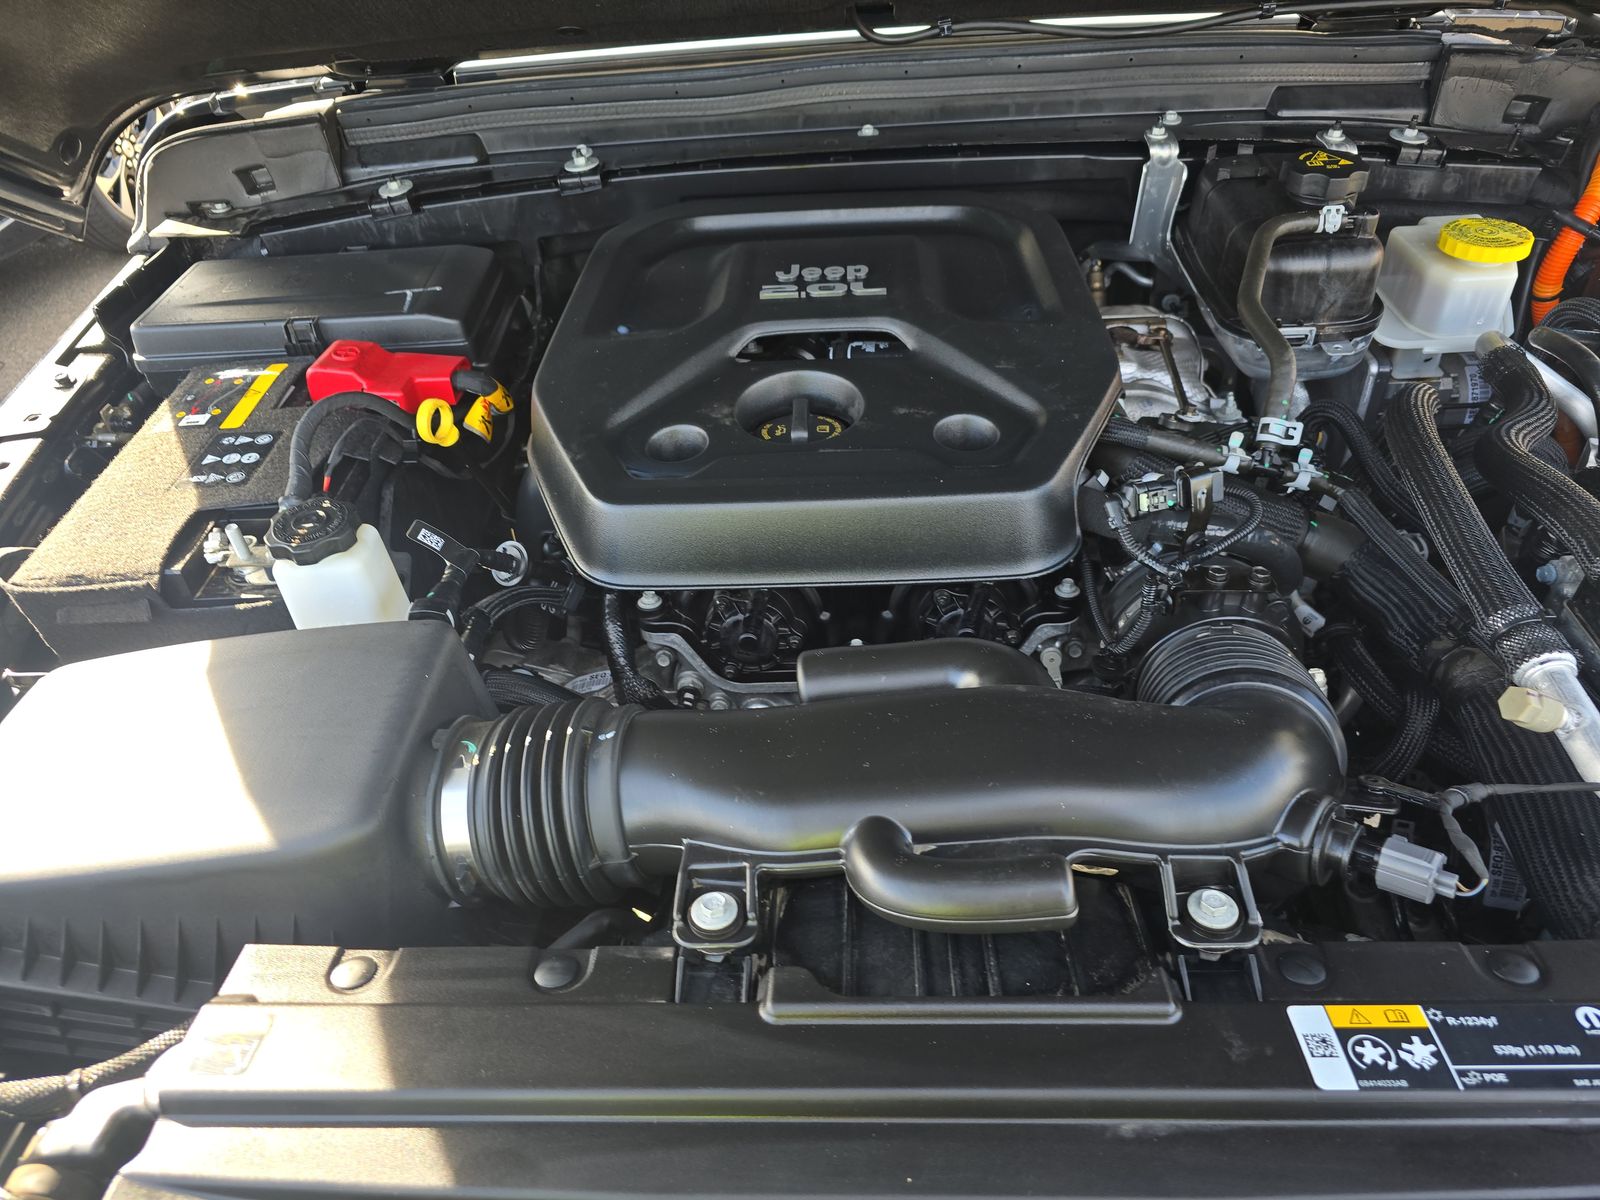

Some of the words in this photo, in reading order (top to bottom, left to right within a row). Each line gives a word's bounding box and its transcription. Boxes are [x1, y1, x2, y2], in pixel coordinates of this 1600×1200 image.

[775, 263, 869, 282] Jeep
[760, 281, 887, 300] 2.0L
[1445, 1015, 1499, 1028] R-1234yf
[1482, 1072, 1510, 1083] POE
